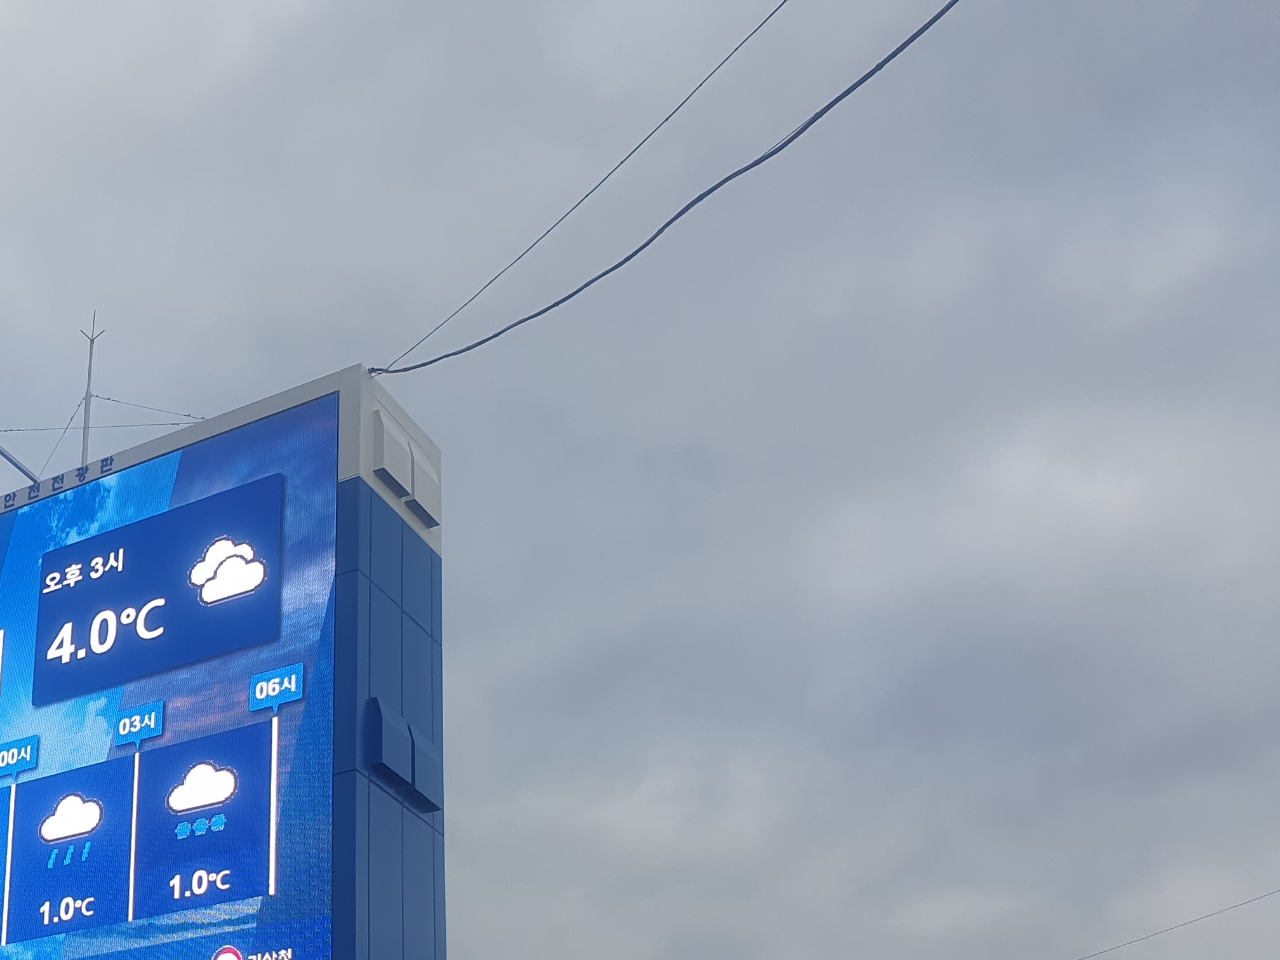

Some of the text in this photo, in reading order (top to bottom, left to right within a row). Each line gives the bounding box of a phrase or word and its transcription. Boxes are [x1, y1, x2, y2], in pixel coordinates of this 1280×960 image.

[42, 547, 124, 594] 오후 3시
[255, 674, 297, 699] 06시
[119, 711, 156, 736] 03시
